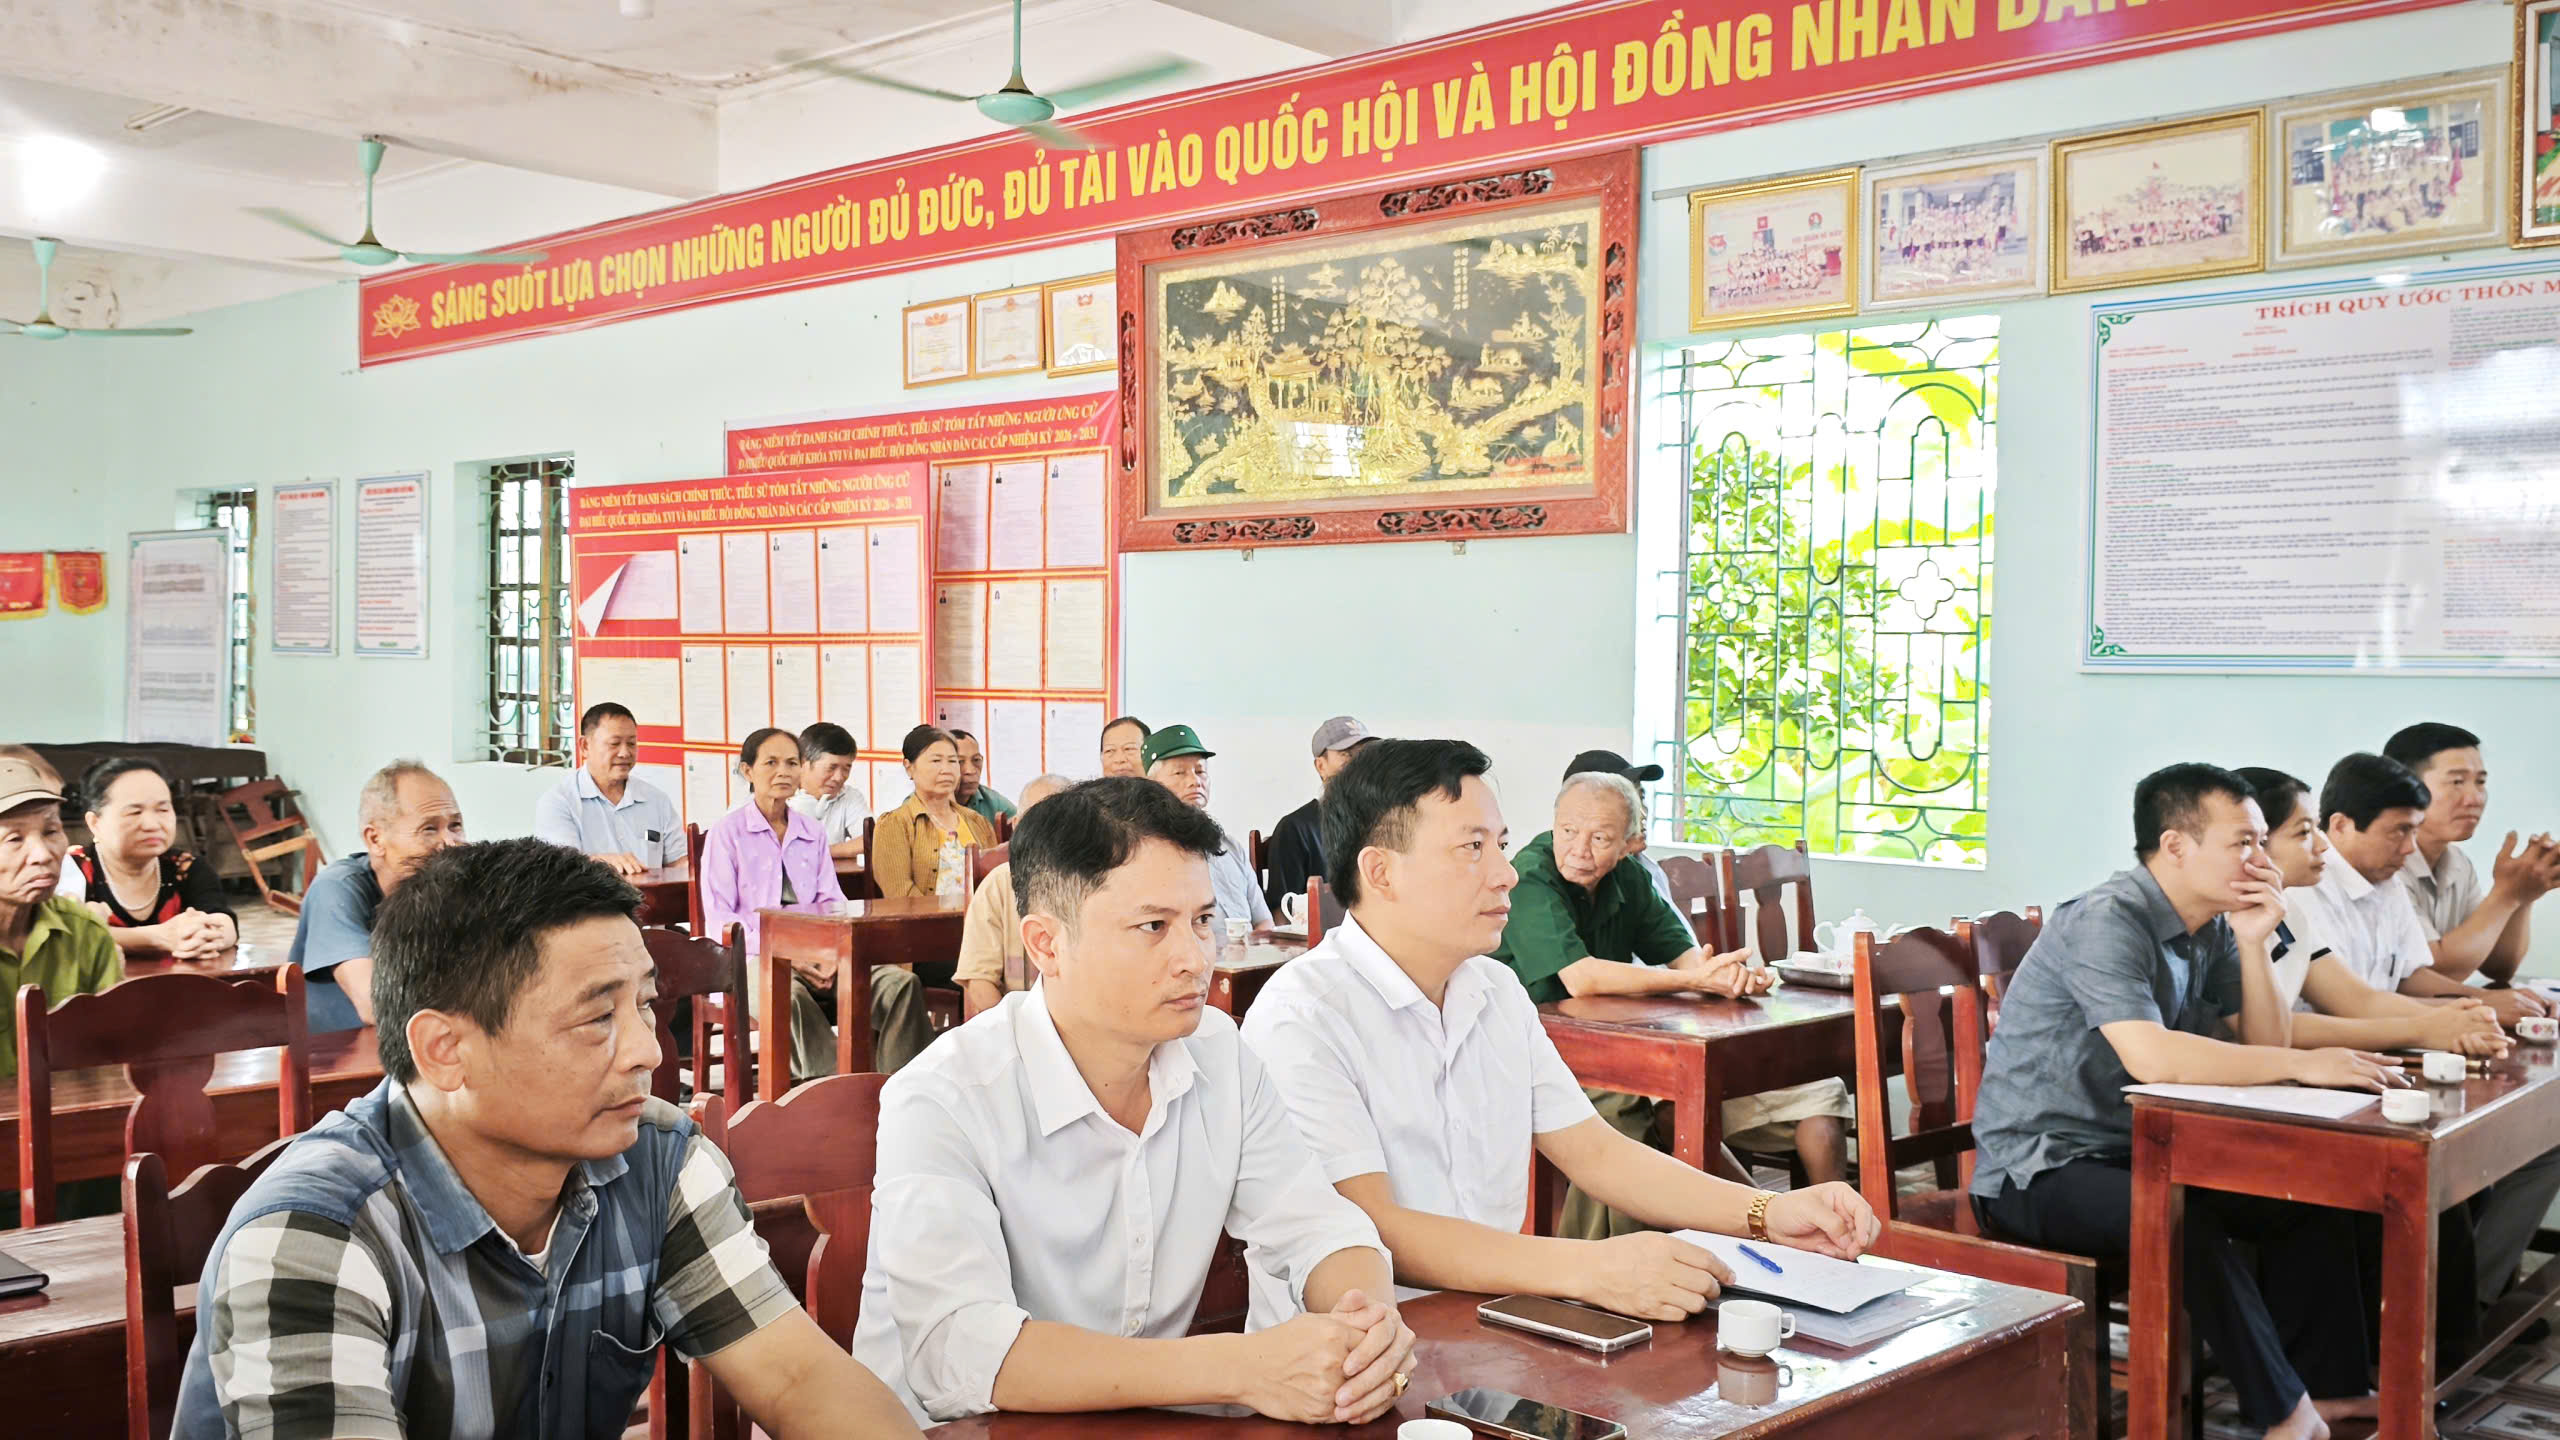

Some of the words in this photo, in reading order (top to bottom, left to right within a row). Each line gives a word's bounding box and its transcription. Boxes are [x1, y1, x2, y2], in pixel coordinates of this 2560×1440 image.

[431, 281, 488, 329] SÁNG
[491, 262, 547, 318] SUỐT
[551, 258, 595, 312] LỰA
[600, 244, 667, 299] CHỌN
[672, 222, 765, 283] NHỮNG
[771, 194, 861, 264] NGƯỜI
[868, 177, 911, 246] ĐỦ
[918, 172, 995, 237] ĐỨC,
[1003, 148, 1051, 221] ĐỦ
[1059, 144, 1117, 209] TÀI
[1127, 128, 1204, 198] VÀO
[1215, 92, 1329, 186] QUỐC
[1342, 79, 1419, 163] HỘI
[1432, 60, 1496, 140] VÀ
[1510, 42, 1598, 132] HỘI
[1612, 8, 1773, 106] ĐỒNG
[2256, 298, 2331, 320] TRÍCH
[2338, 295, 2392, 314] QUY
[2398, 287, 2452, 306] ƯỚC
[2458, 280, 2535, 301] THÔN
